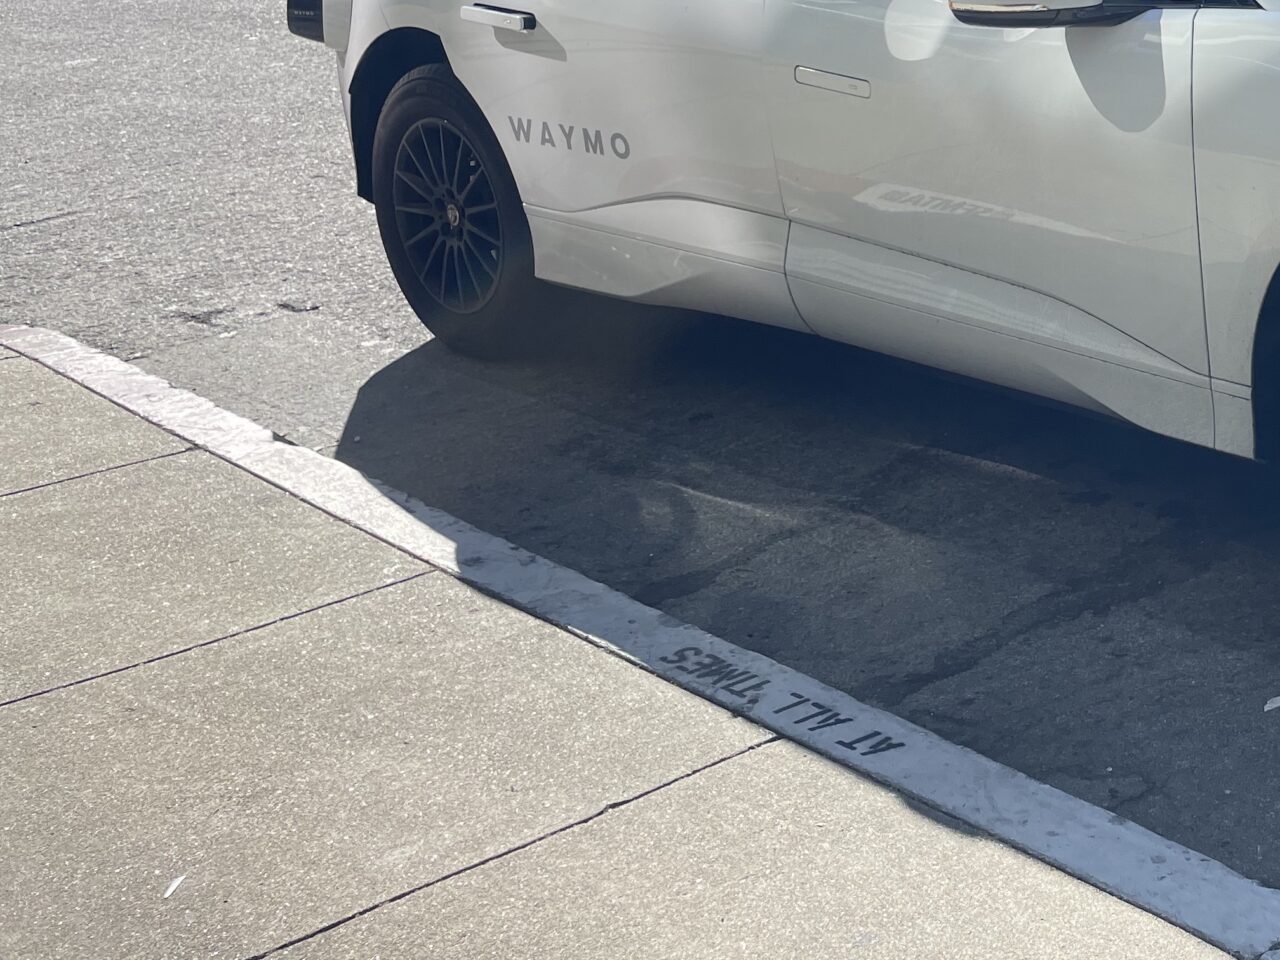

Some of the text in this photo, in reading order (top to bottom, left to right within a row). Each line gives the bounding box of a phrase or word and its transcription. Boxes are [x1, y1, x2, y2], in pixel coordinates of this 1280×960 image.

[507, 115, 631, 160] WAYMO
[659, 646, 907, 756] AT ALL TIMES
